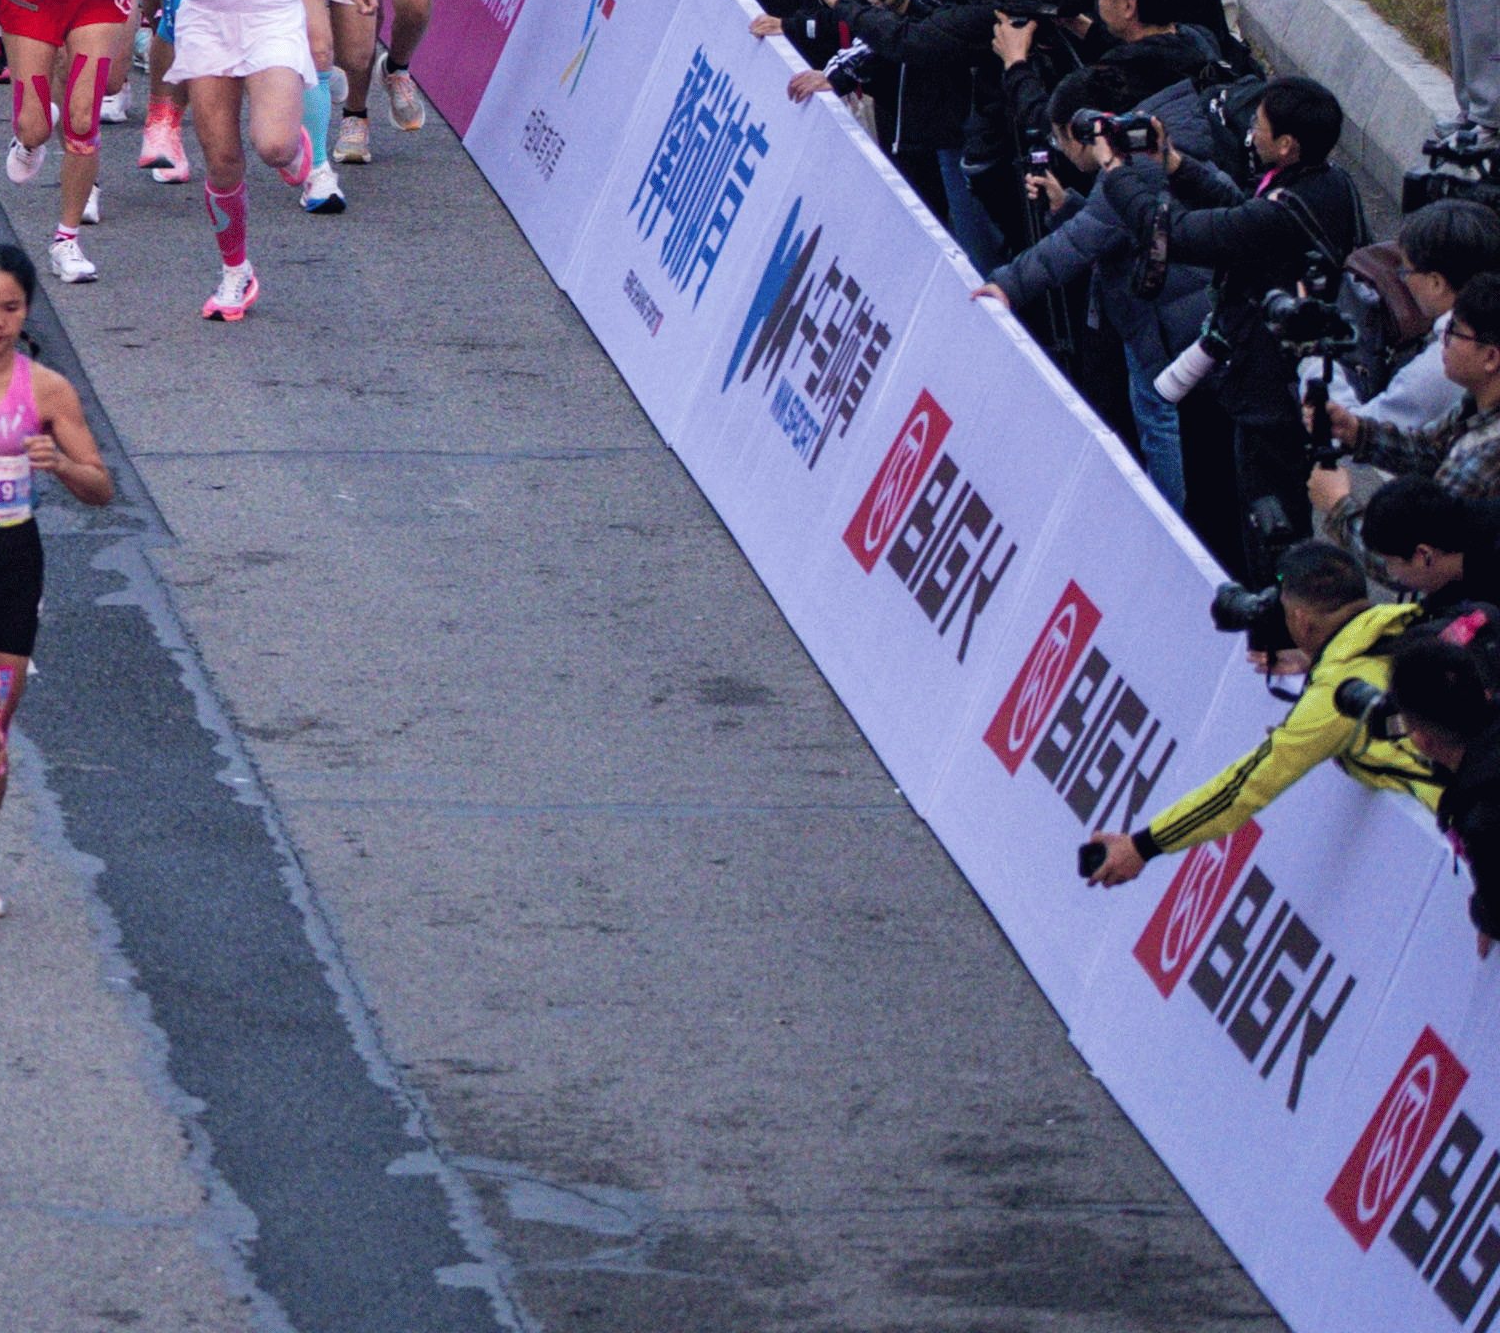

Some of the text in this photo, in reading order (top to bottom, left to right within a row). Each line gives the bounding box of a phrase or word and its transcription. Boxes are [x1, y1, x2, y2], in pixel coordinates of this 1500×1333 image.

[887, 452, 1018, 663] BIGK
[1031, 646, 1178, 841] BIGK
[1187, 865, 1358, 1115] BIGK
